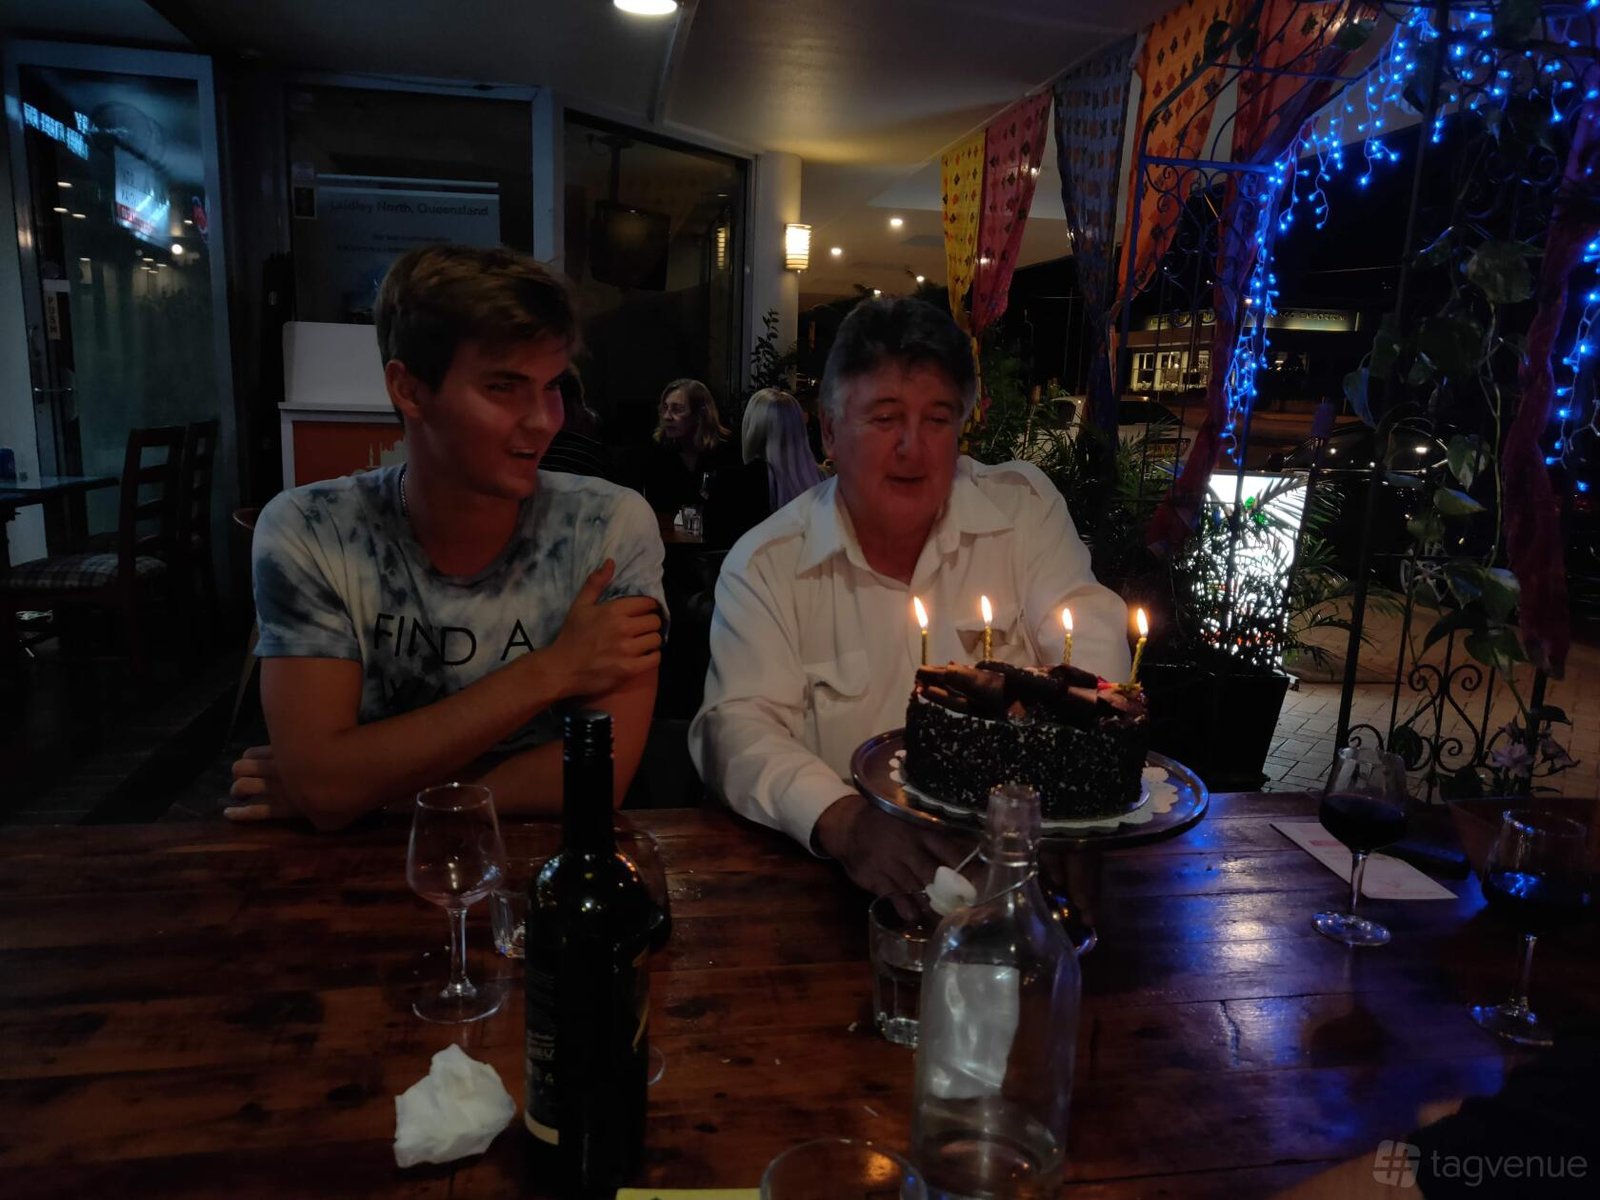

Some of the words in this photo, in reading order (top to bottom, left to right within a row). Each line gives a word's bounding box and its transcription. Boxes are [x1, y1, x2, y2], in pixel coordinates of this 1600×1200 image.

[417, 203, 489, 216] Queensland
[47, 295, 58, 334] PUSH
[374, 612, 477, 666] FIND
[500, 618, 535, 661] A
